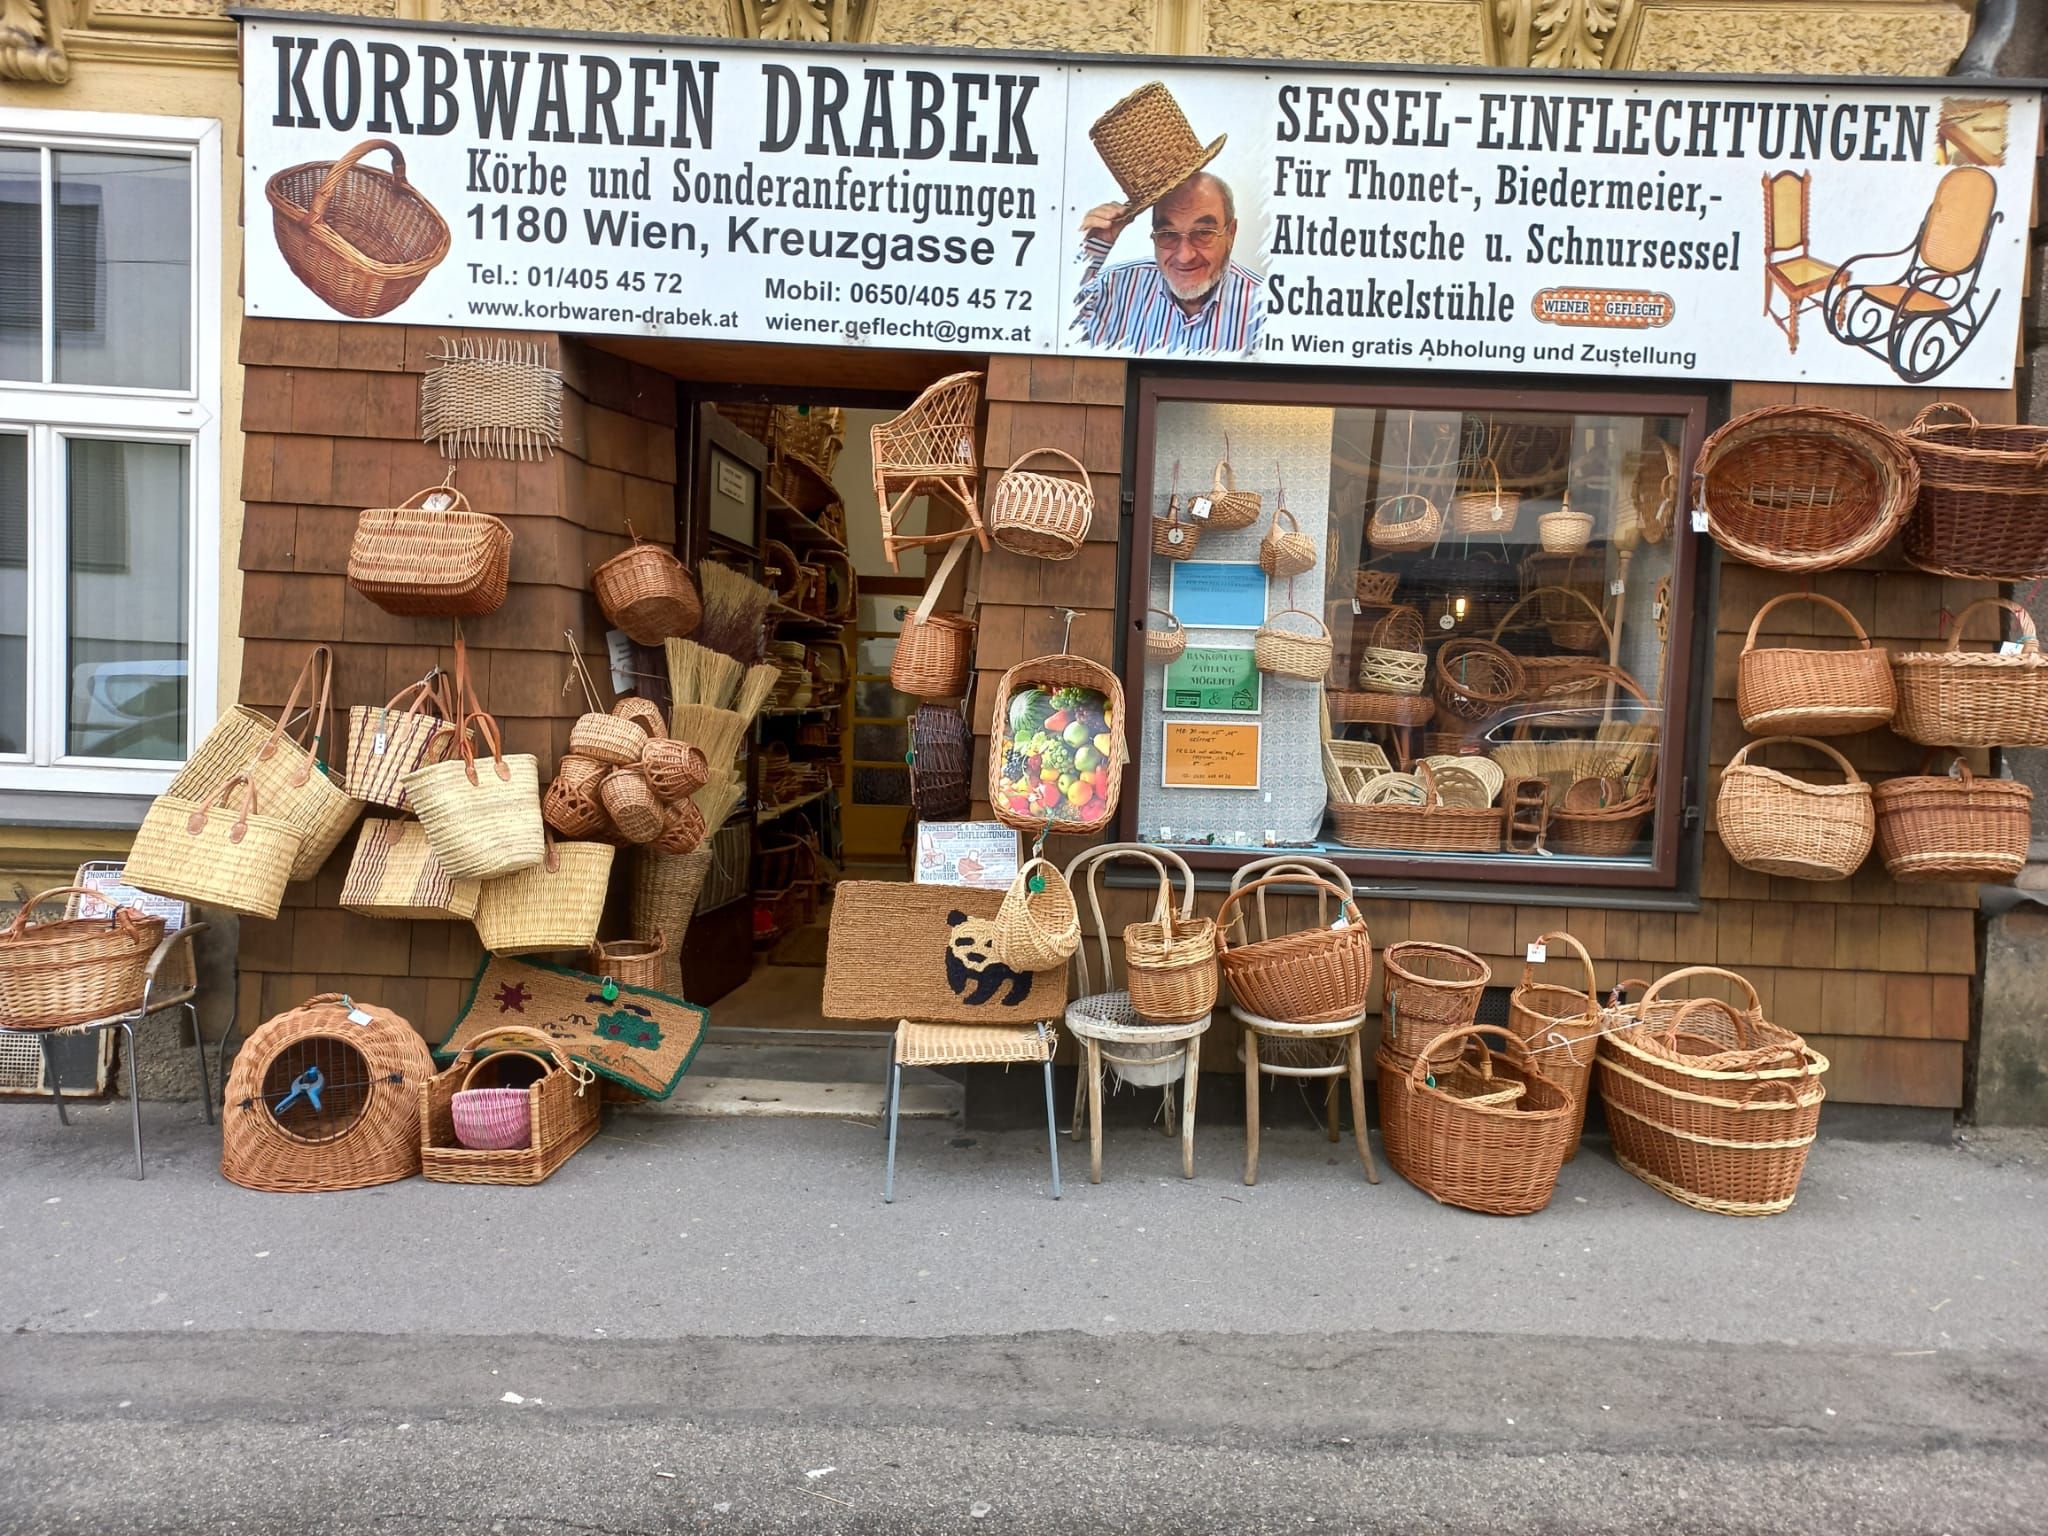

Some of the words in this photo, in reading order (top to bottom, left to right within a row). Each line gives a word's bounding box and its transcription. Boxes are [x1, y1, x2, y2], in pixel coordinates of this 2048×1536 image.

[272, 36, 721, 151] KORBWAREN
[759, 63, 1040, 165] DRABEK
[1276, 85, 1930, 162] SESSEL-EINFLECHTUNGEN
[467, 149, 566, 196] Körbe
[589, 157, 650, 200] und
[672, 158, 1037, 226] Sonderanfertigungen
[1274, 157, 1330, 197] Für
[1346, 159, 1480, 211] Thonet-,
[468, 204, 566, 243] 1180
[584, 209, 708, 257] Wien,
[729, 216, 994, 269] Kreuzgasse
[1012, 231, 1034, 266] 7
[1271, 215, 1464, 260] Altdeutsche
[1486, 235, 1511, 261] u.
[1527, 224, 1739, 270] Schnursessel
[467, 263, 519, 286] Tel.:
[528, 266, 608, 290] 01/405
[616, 270, 645, 292] 45
[654, 272, 682, 294] 72
[765, 278, 840, 302] Mobil:
[851, 283, 957, 307] 0650/405
[967, 288, 996, 309] 45
[1004, 289, 1032, 311] 72
[467, 300, 738, 328] www.korbwaren-drabek.at
[1268, 274, 1513, 321] Schaukelstühle
[1543, 299, 1590, 314] WIENER
[1605, 301, 1665, 317] GEFLECHT
[765, 314, 1031, 342] wiener.geflecht@gmx.at
[1264, 333, 1284, 352] In
[1291, 334, 1344, 353] Wien
[1352, 338, 1413, 359] gratis
[1419, 338, 1525, 364] Abholung
[1533, 343, 1574, 361] und
[1580, 344, 1696, 370] Zustellung
[1191, 675, 1236, 686] MÖGLICH
[920, 870, 959, 881] Korbwaren
